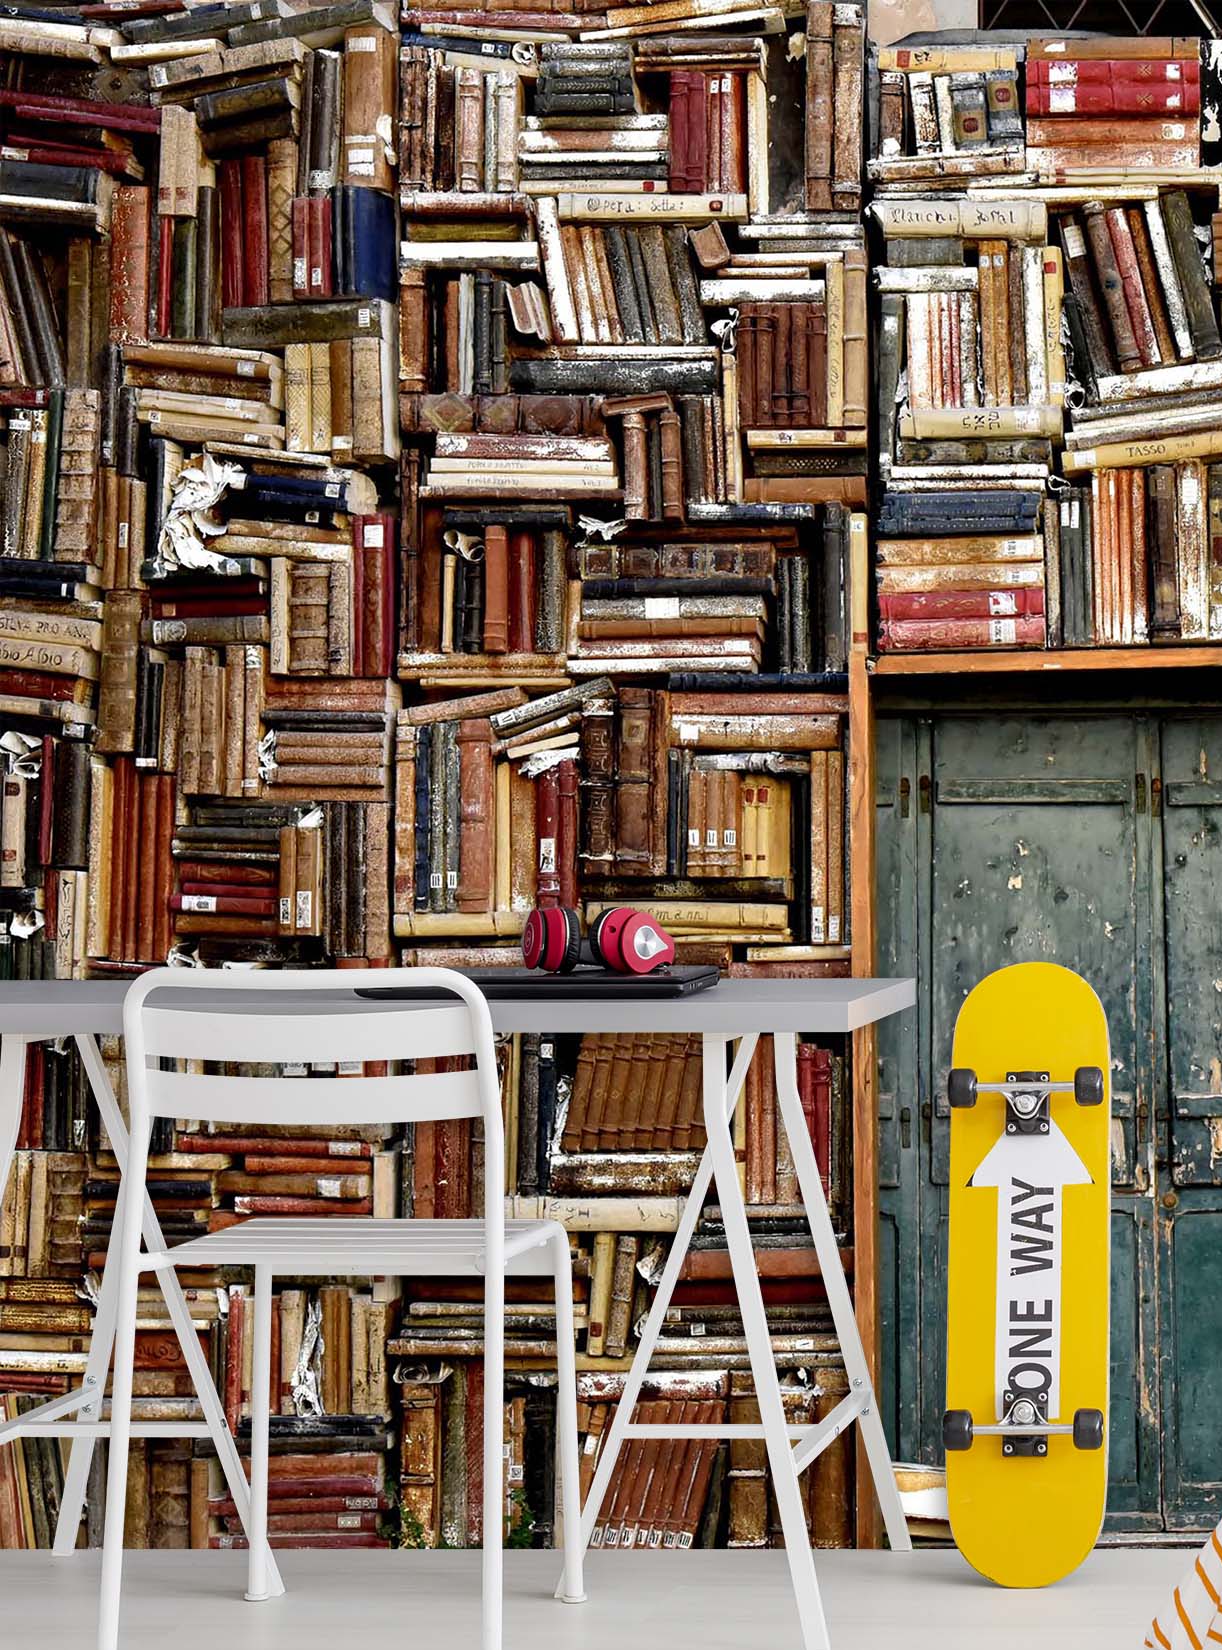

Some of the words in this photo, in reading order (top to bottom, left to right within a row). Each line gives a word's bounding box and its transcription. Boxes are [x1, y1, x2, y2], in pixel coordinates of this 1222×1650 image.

[1125, 443, 1167, 459] TASSO
[1010, 1176, 1054, 1277] WAY
[1008, 1299, 1053, 1392] ONE
